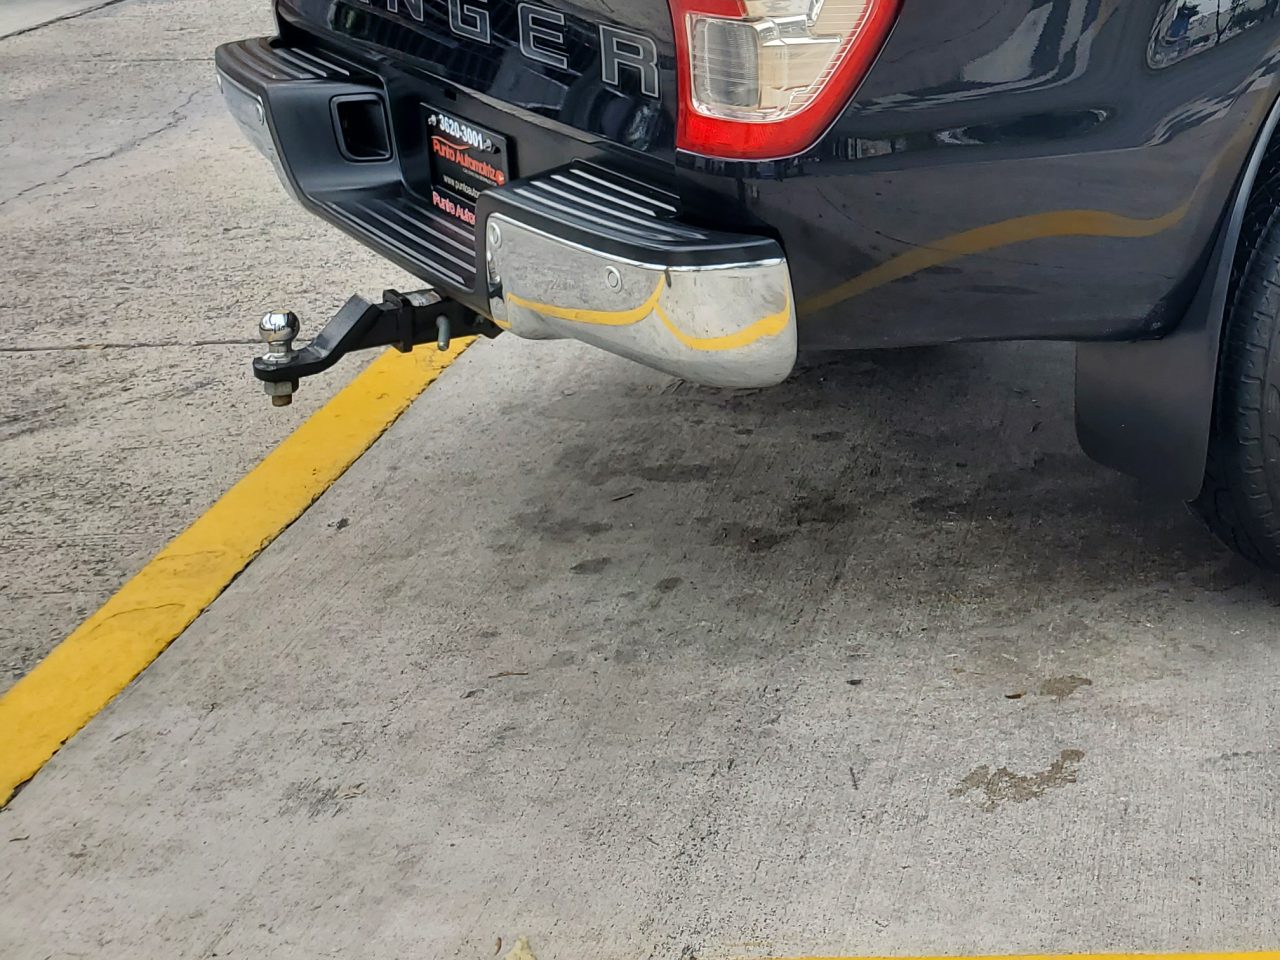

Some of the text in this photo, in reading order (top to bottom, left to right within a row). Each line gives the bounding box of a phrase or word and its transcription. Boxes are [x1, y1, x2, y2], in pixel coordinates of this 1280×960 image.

[438, 114, 484, 150] 3620-3001
[432, 139, 455, 162] Punto
[432, 191, 455, 215] Punto
